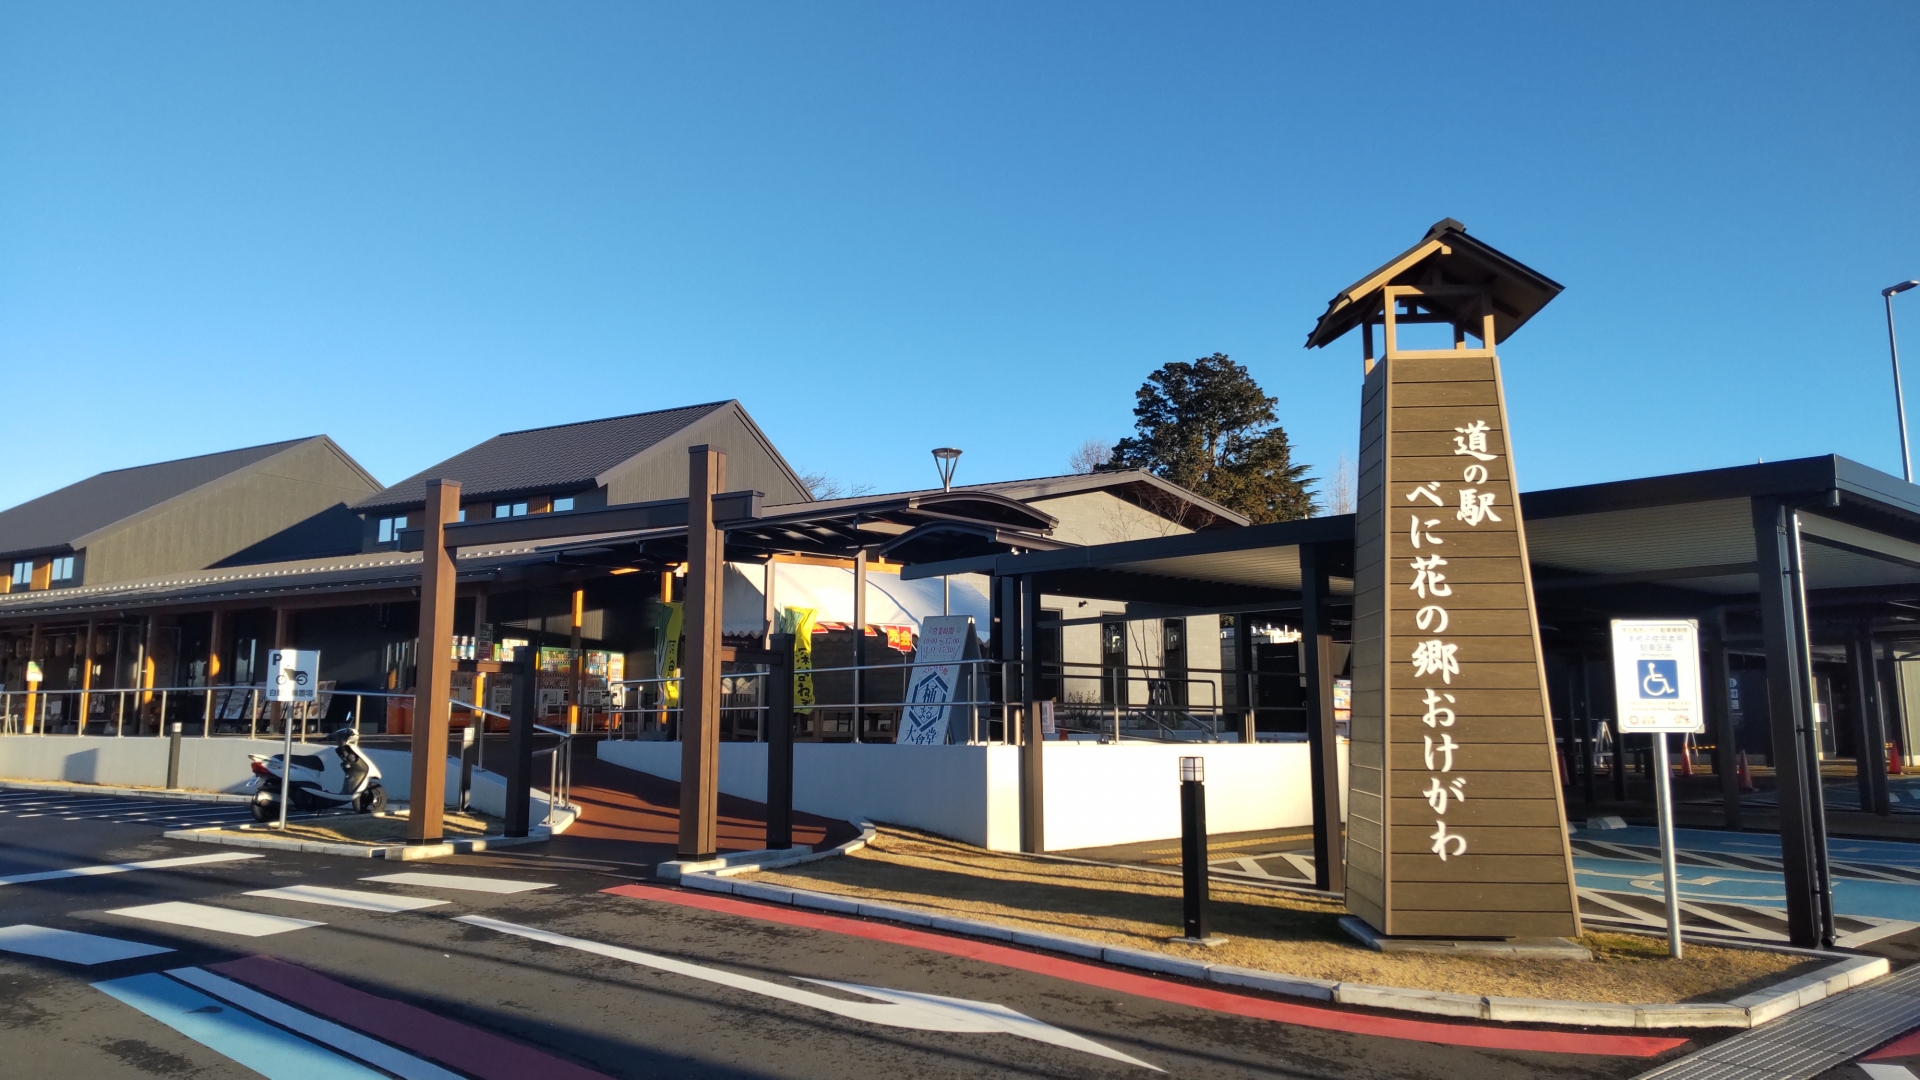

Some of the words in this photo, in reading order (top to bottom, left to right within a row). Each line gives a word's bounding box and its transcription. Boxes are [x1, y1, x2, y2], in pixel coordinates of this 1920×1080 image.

[1453, 420, 1502, 526] 道の駅
[272, 654, 282, 665] P
[1406, 481, 1467, 862] べに花の郷おけがわ
